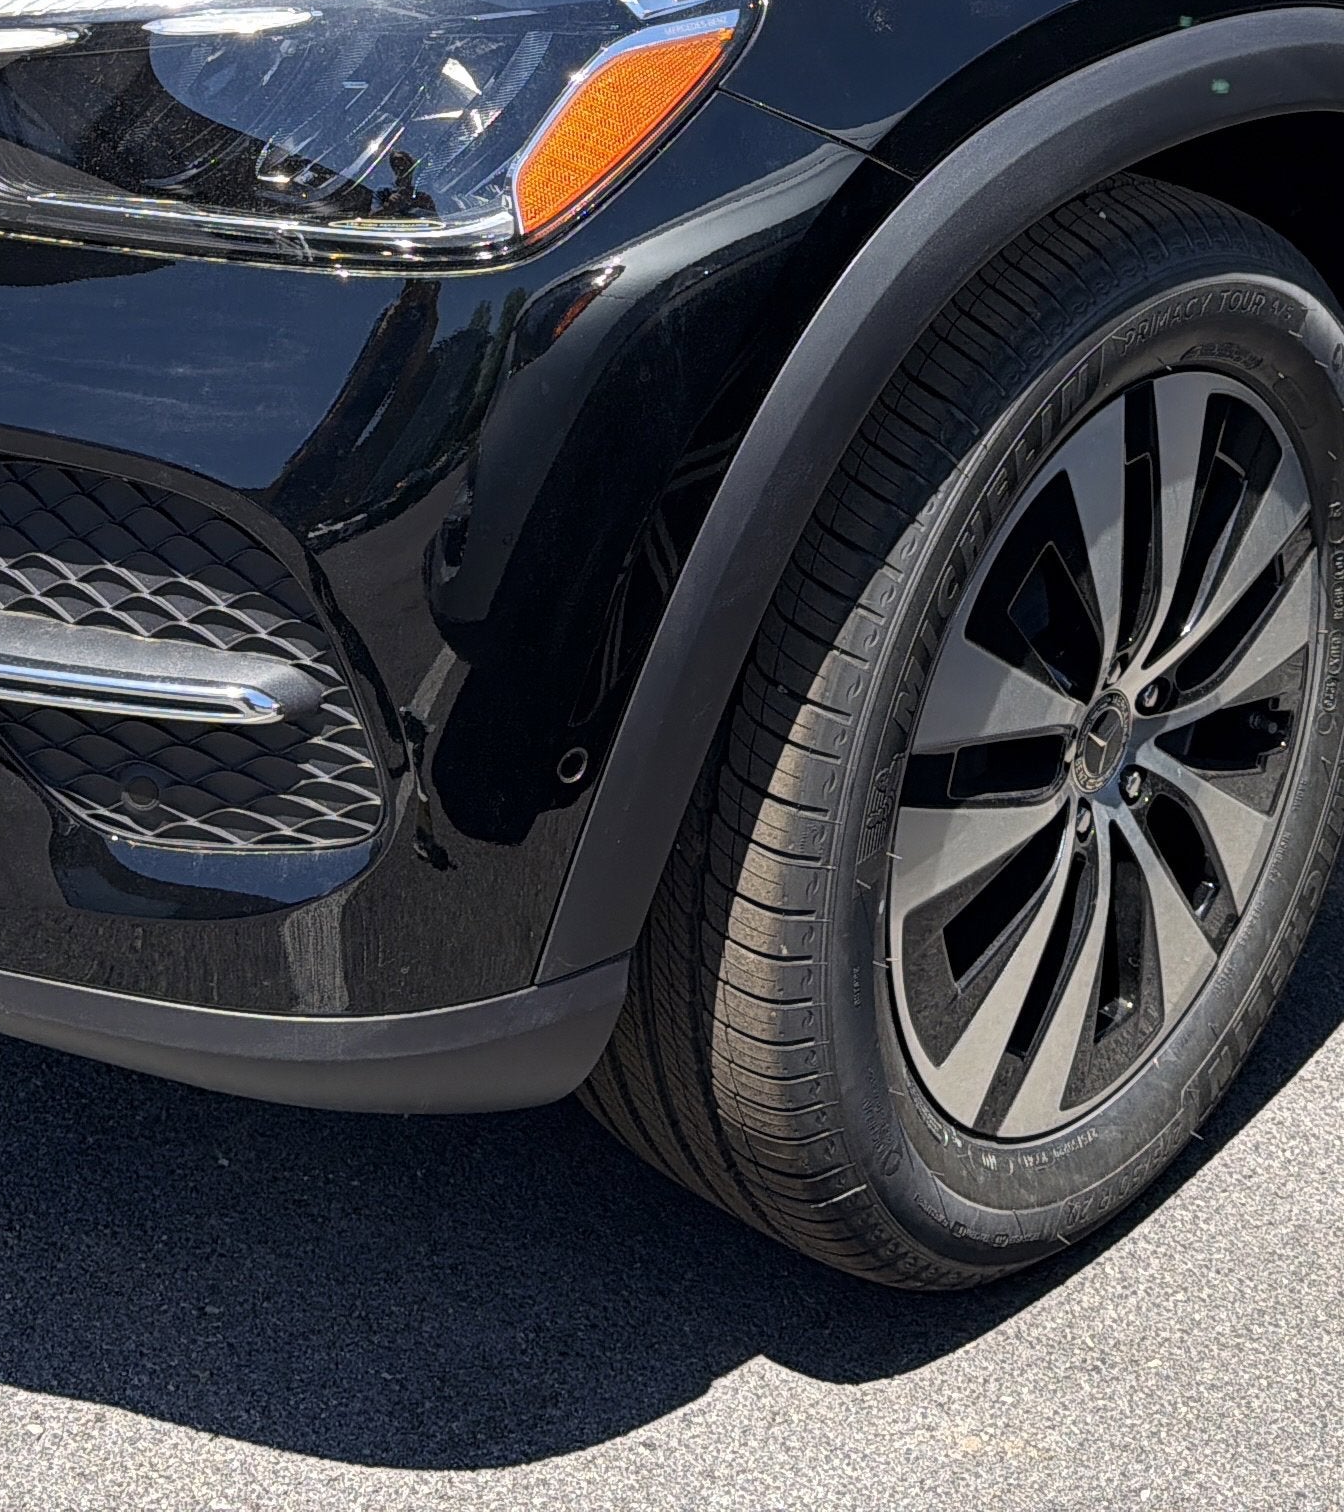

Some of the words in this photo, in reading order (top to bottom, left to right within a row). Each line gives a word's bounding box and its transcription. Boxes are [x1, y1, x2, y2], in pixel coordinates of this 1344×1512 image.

[892, 362, 1090, 736] MICHELIN
[1120, 291, 1214, 357] PRIMACY
[1218, 290, 1267, 315] TOUR
